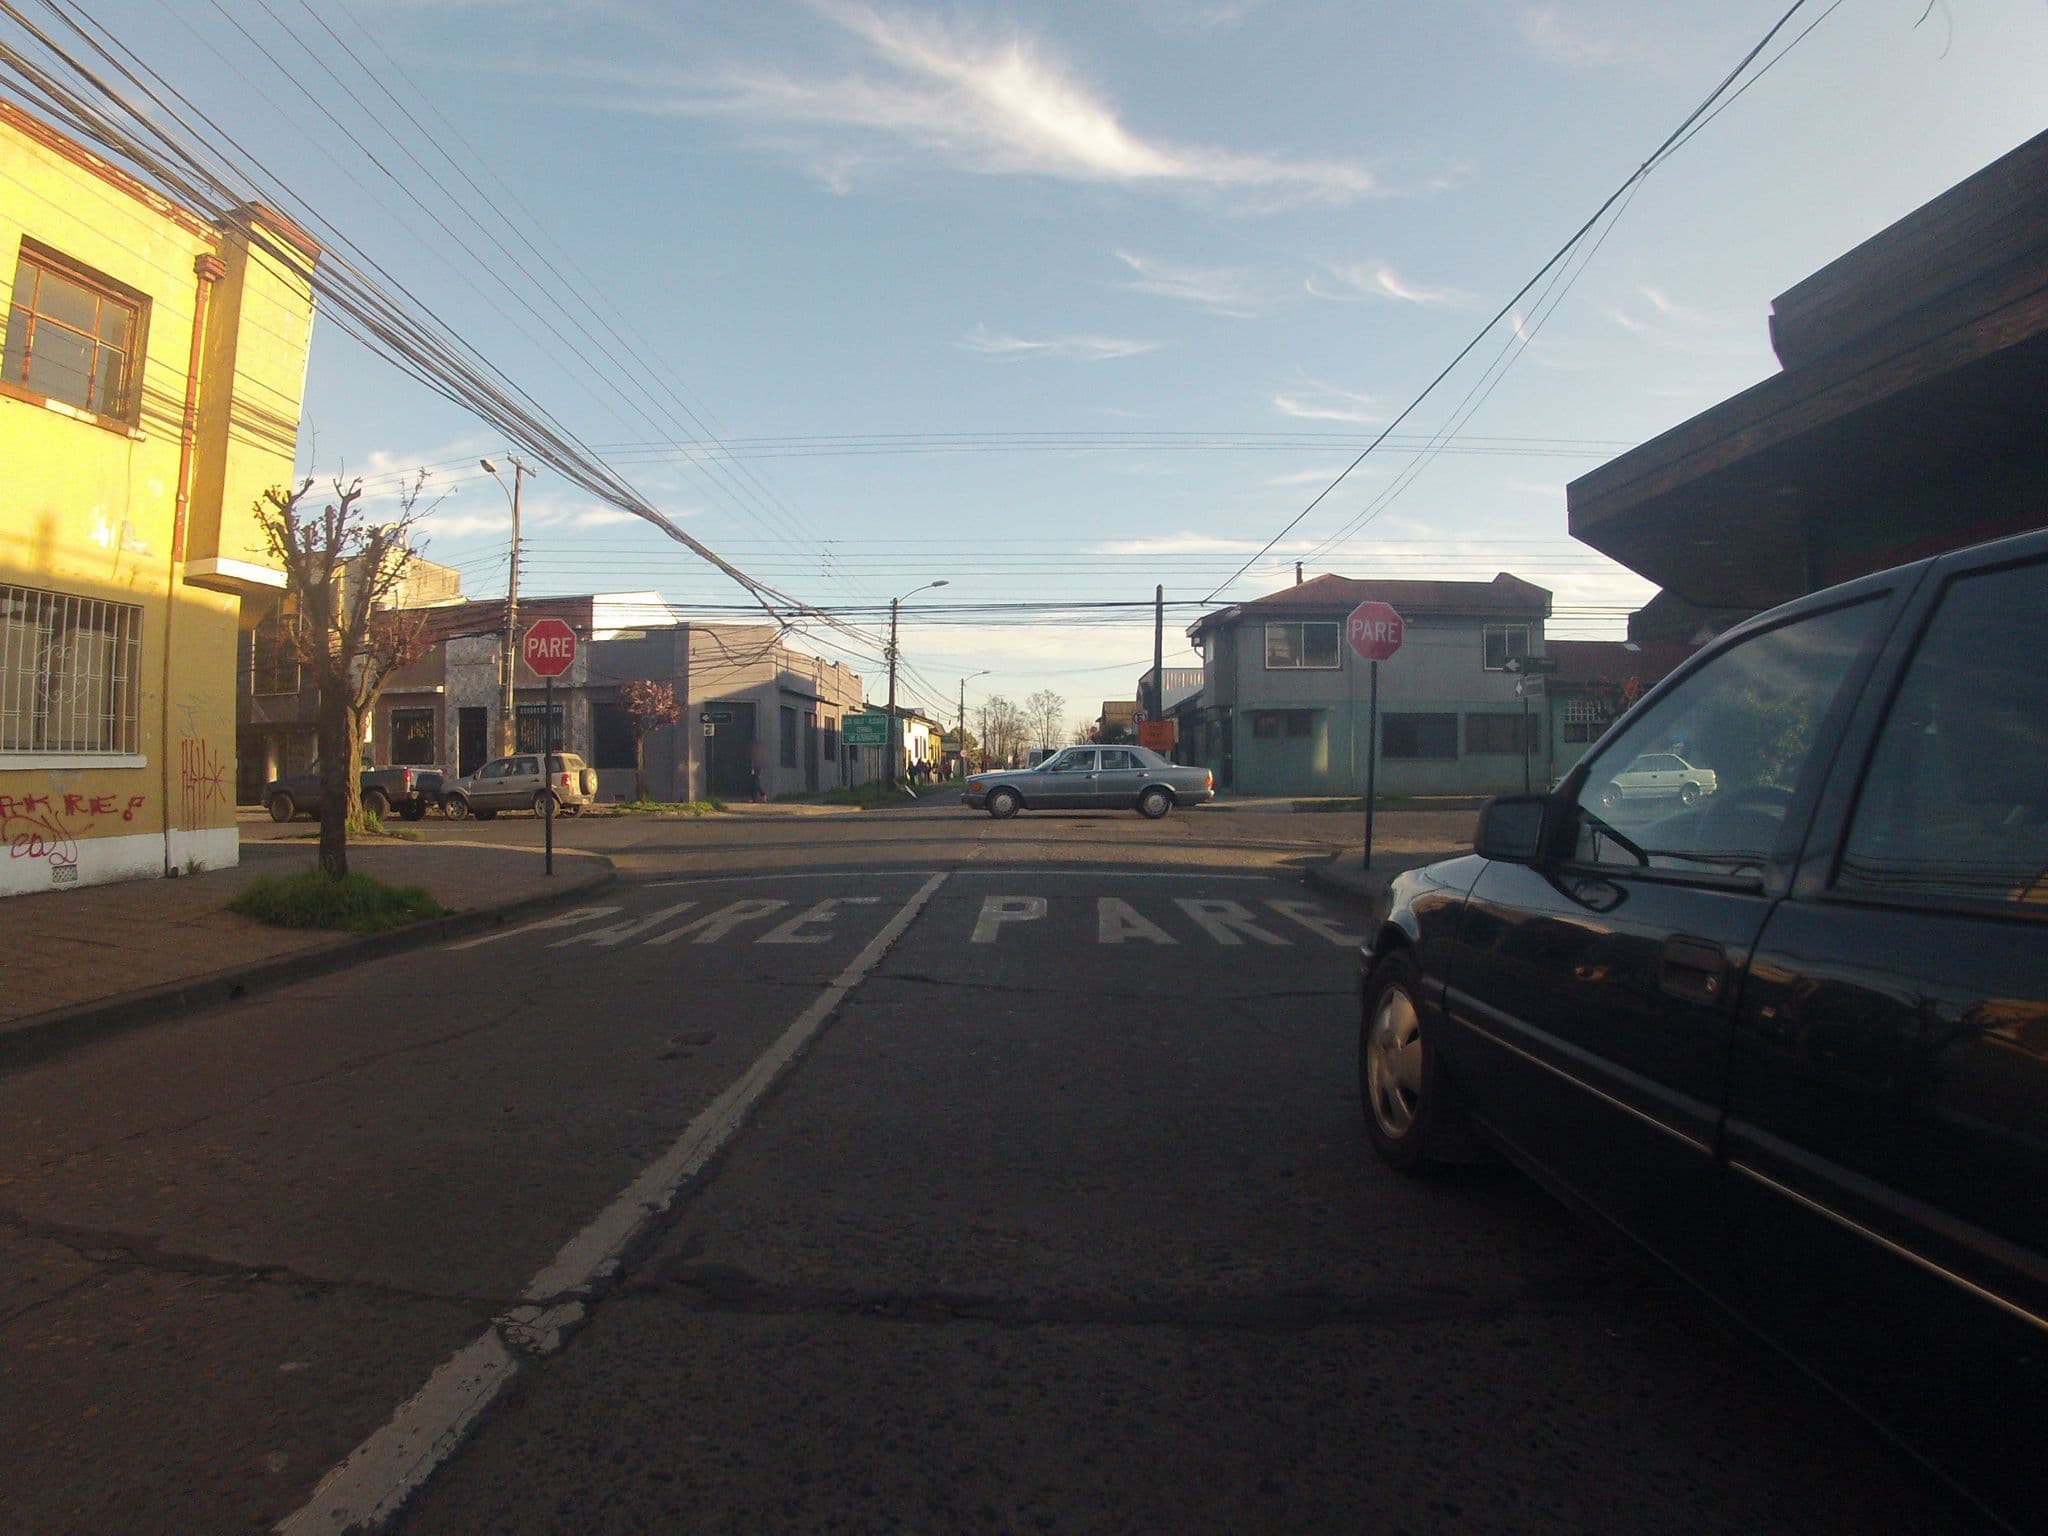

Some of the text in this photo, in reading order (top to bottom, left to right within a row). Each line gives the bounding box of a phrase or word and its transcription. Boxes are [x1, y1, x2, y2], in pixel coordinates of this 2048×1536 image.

[528, 637, 572, 658] PARE
[1352, 619, 1398, 643] PARE
[442, 896, 881, 951] PARE
[971, 896, 1371, 947] PARE
